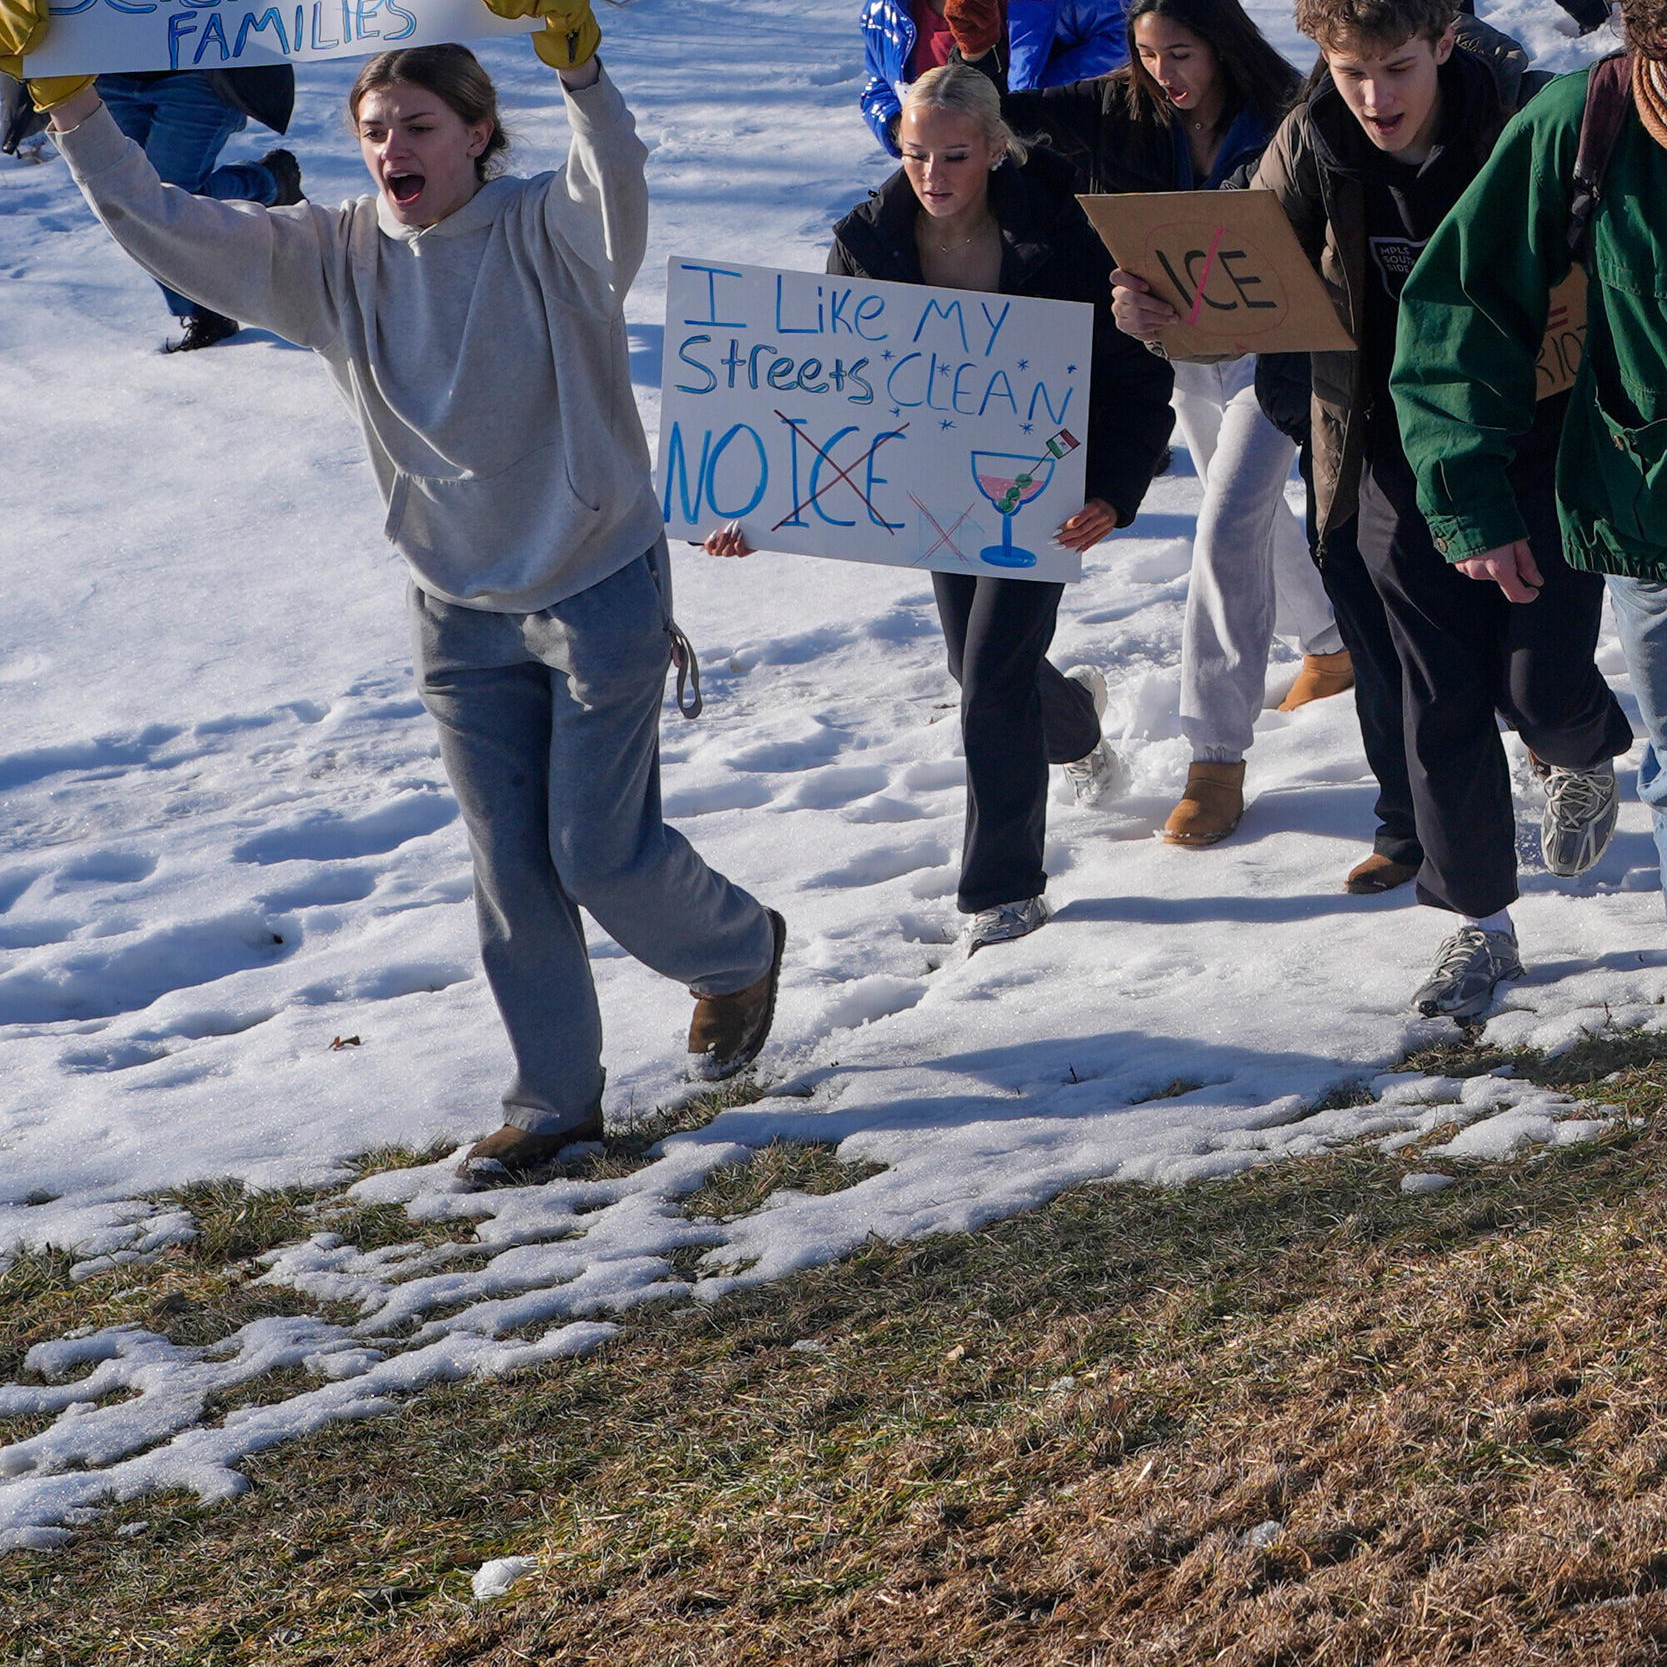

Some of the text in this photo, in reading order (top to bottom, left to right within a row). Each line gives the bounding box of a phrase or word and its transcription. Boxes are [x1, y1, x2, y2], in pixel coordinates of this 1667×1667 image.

[1156, 249, 1278, 311] ICE
[1380, 246, 1409, 255] MPLS
[1386, 265, 1410, 274] SIDE
[681, 264, 748, 329] I
[913, 299, 1010, 357] MY
[674, 335, 1073, 426] Streets CLEAN
[664, 410, 909, 534] NO ICE
